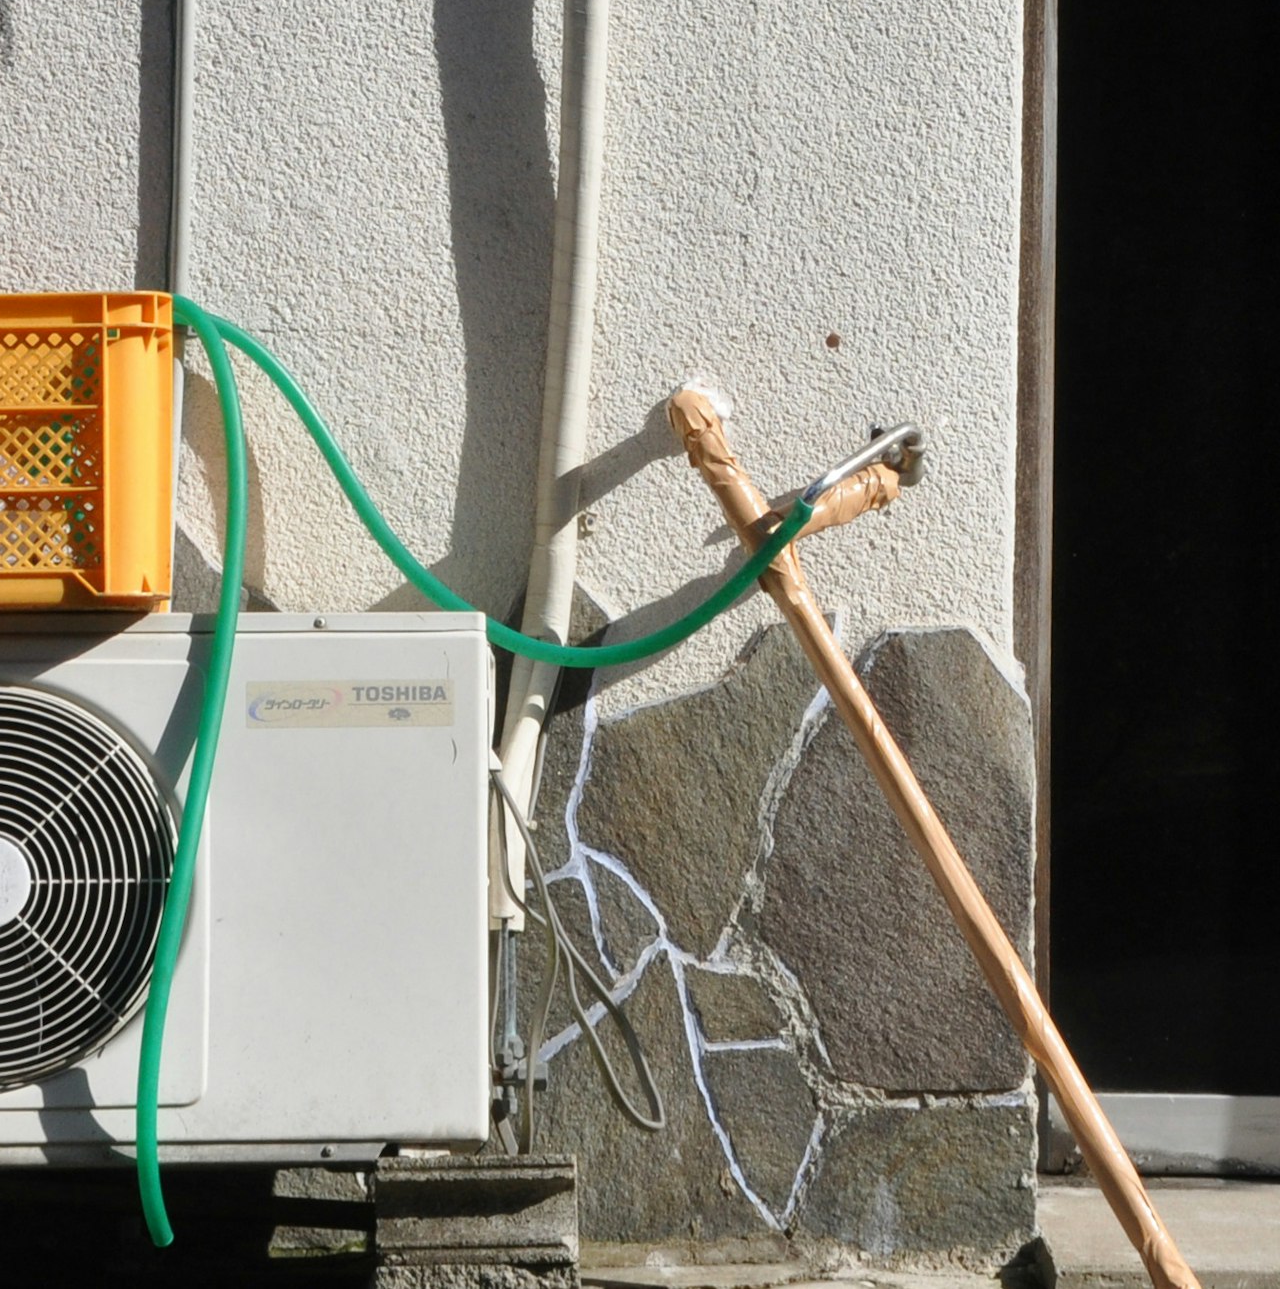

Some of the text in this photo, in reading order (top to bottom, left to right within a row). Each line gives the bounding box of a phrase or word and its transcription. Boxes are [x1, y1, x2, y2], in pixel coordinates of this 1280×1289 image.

[352, 686, 447, 702] TOSHIBA
[264, 698, 331, 711] ツインロータリー
